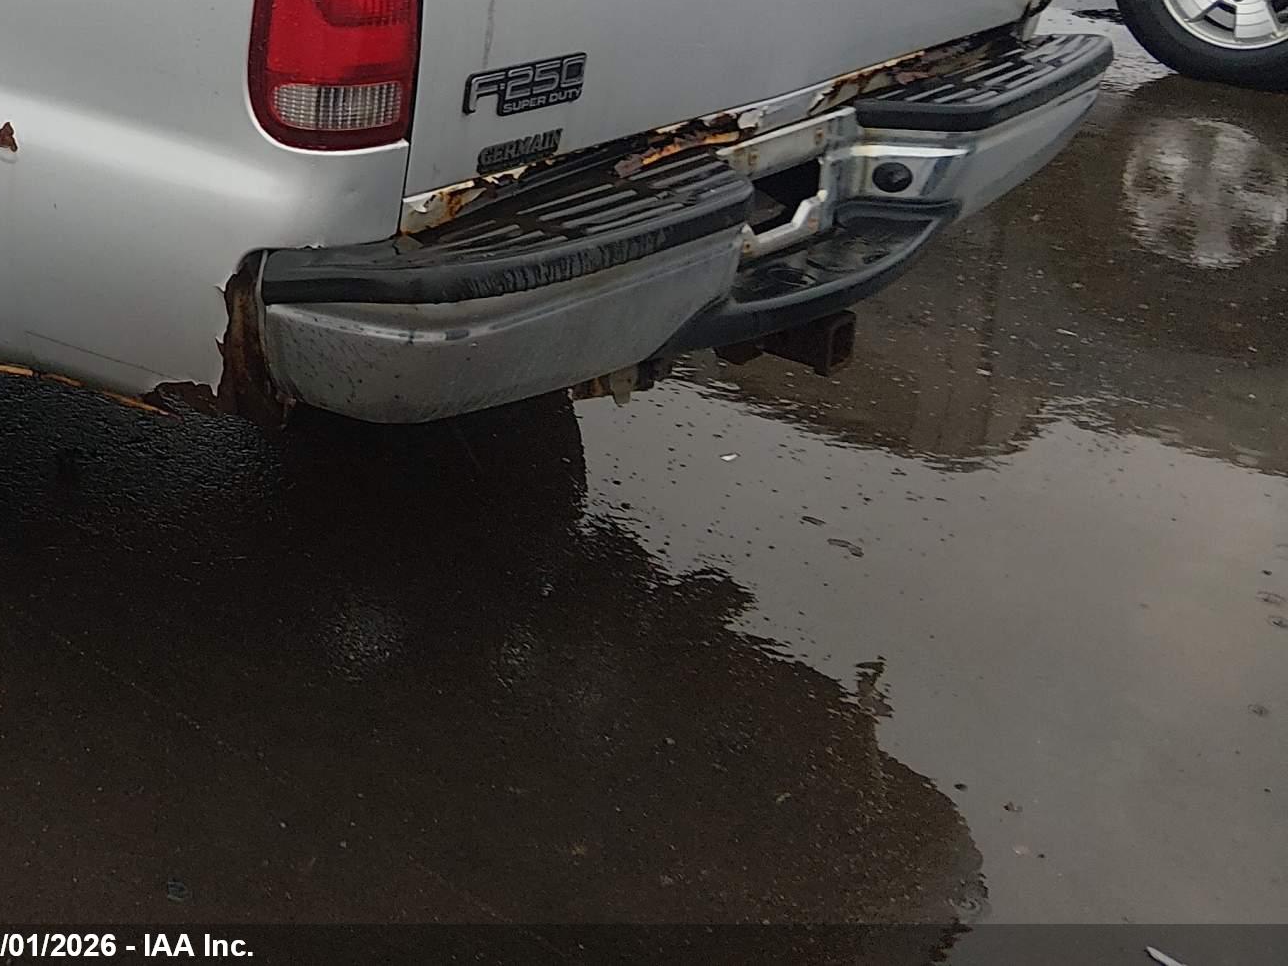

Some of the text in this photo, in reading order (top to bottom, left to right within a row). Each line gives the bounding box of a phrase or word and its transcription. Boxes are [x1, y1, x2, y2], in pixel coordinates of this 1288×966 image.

[503, 89, 581, 113] SUPER DUTY
[477, 128, 562, 168] GERMAIN
